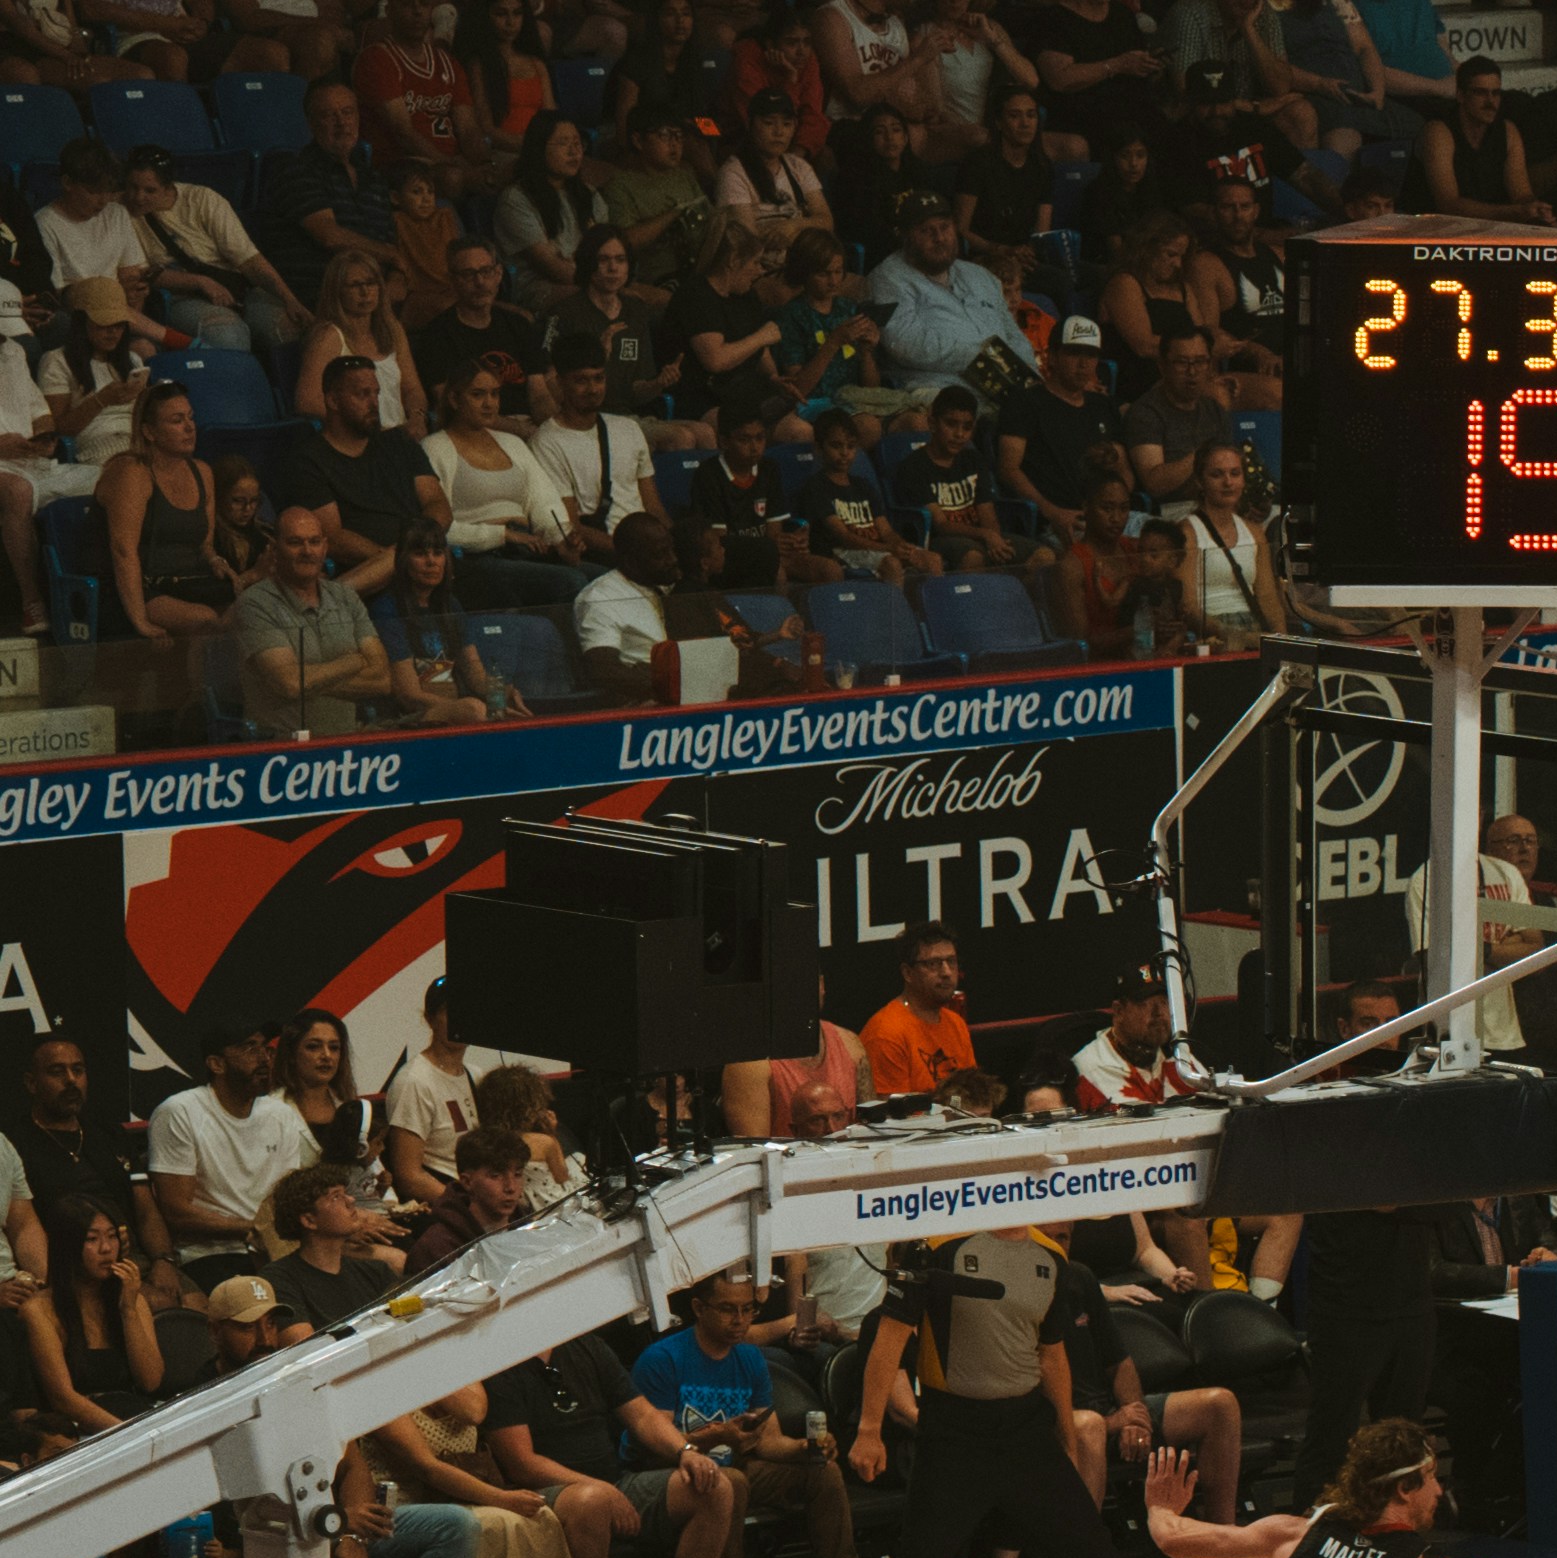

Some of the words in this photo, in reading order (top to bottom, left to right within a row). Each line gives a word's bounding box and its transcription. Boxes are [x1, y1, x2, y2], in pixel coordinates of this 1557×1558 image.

[1450, 26, 1527, 53] ROWN
[618, 683, 1134, 771] LangleyEventsCentre.com
[103, 763, 247, 820] Events
[259, 748, 402, 805] Centre
[814, 746, 1051, 836] Michelob
[816, 827, 1115, 948] LTRA
[1317, 834, 1412, 902] EBL
[856, 1161, 1197, 1220] LangleyEventsCentre.com
